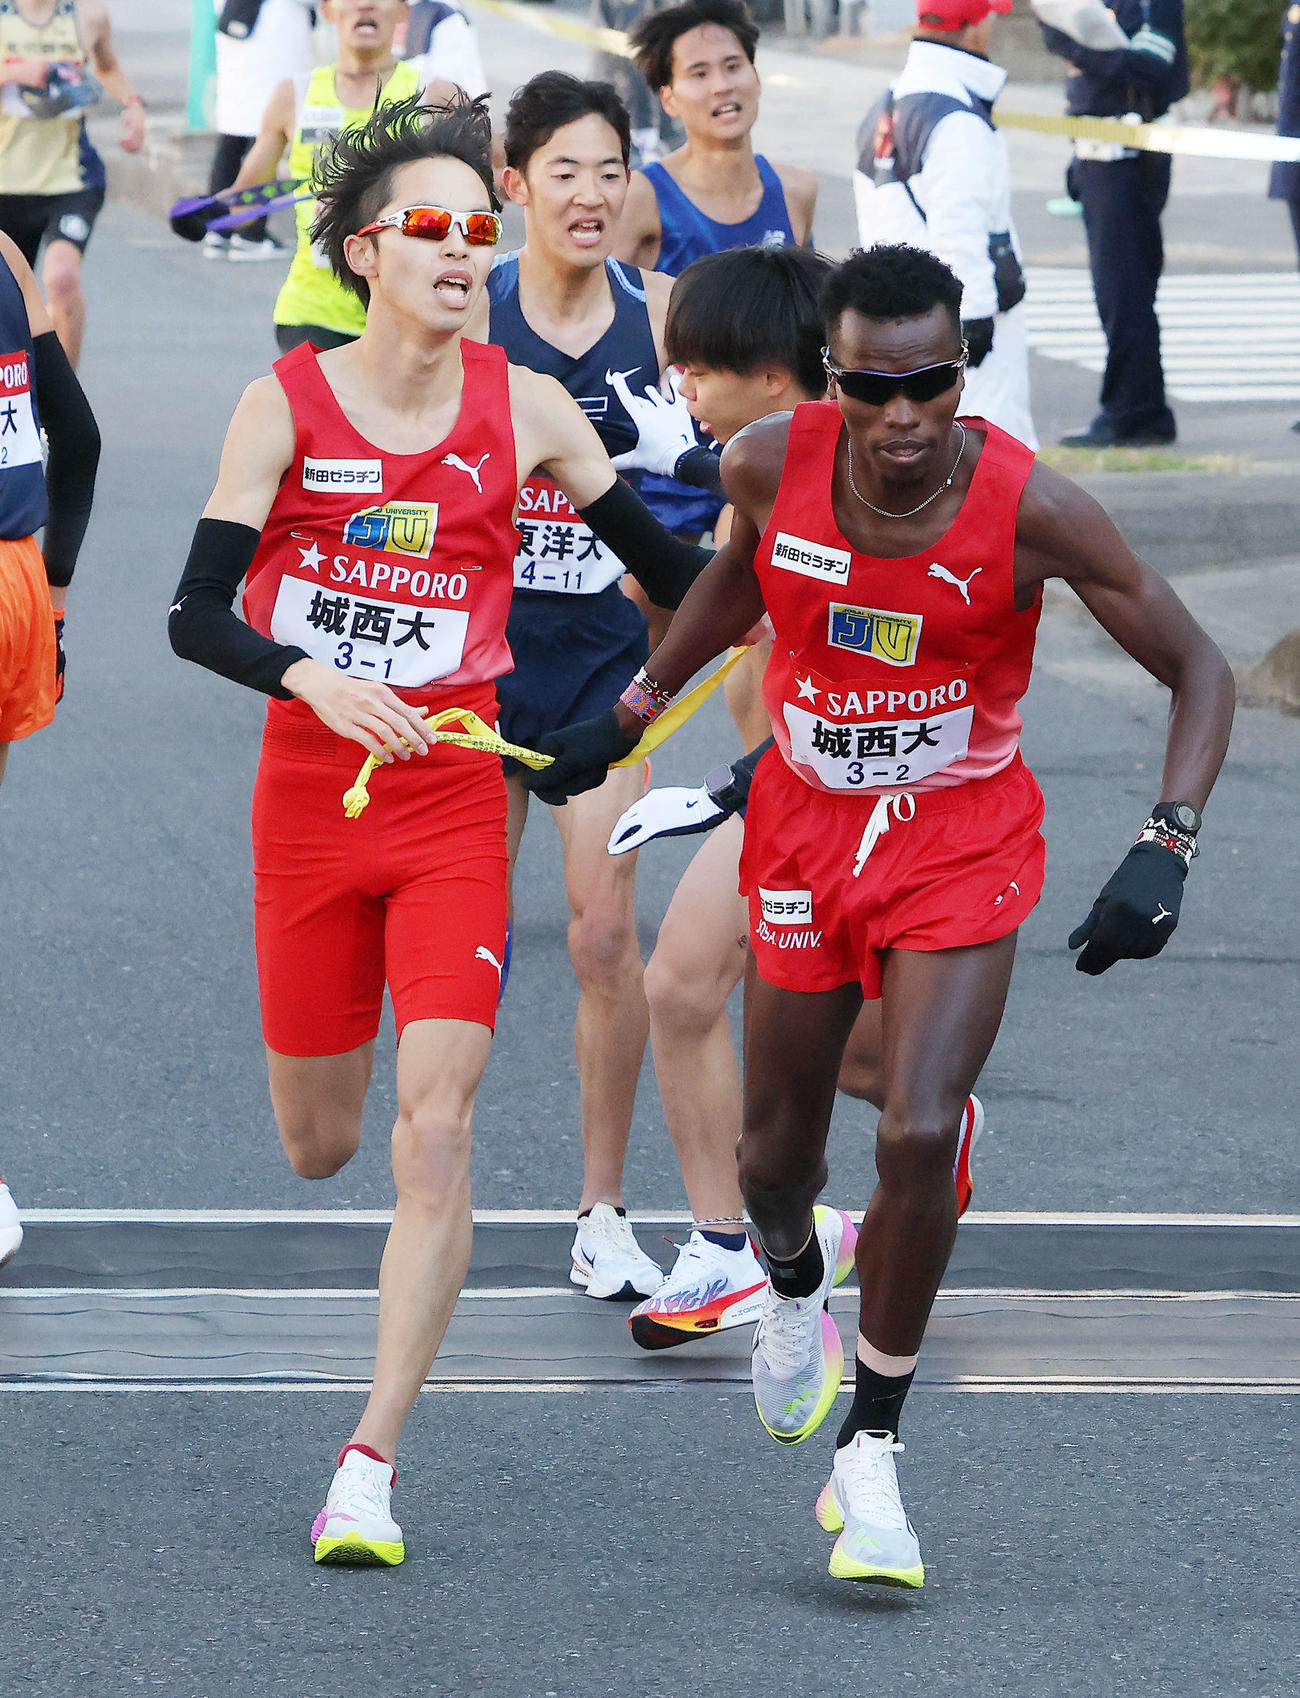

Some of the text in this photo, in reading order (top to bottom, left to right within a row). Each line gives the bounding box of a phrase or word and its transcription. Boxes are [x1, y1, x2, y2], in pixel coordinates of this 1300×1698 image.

[304, 466, 380, 484] 新田ゼラチン
[385, 508, 429, 516] UNIVERSITY
[516, 522, 603, 562] 東洋大
[774, 542, 848, 575] 新田ゼラチン
[330, 554, 467, 601] SAPPORO
[306, 590, 435, 651] 城西大
[837, 614, 912, 662] JU
[334, 641, 393, 679] 3-1
[826, 678, 967, 717] SAPPORO
[811, 719, 942, 759] 城西大
[846, 761, 909, 785] 3-2
[778, 930, 823, 949] UNIV.
